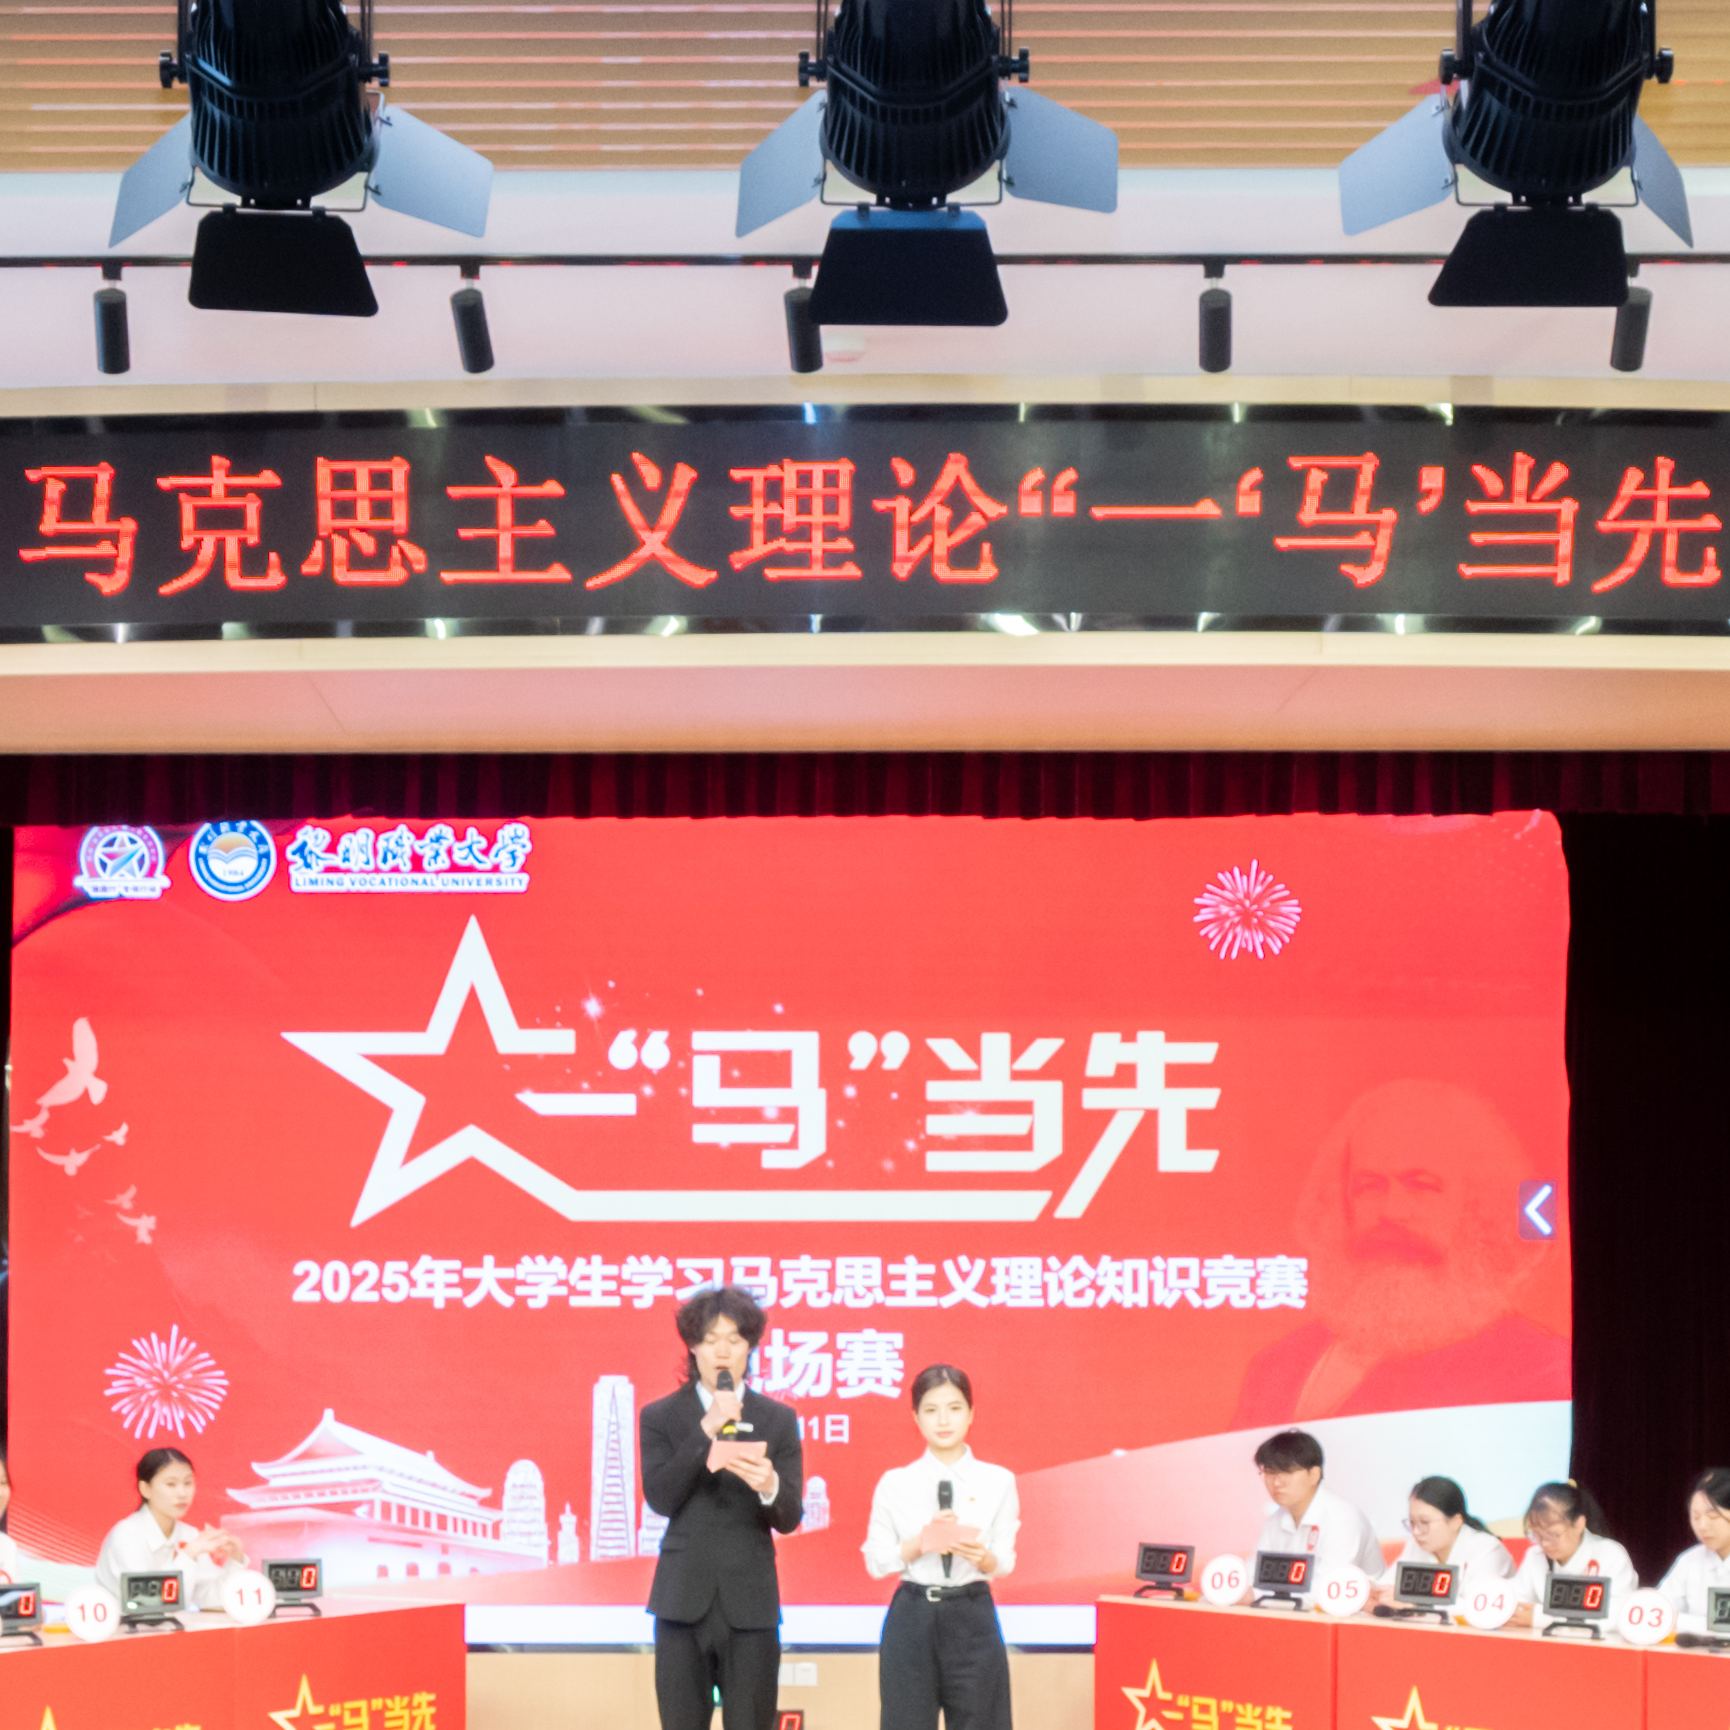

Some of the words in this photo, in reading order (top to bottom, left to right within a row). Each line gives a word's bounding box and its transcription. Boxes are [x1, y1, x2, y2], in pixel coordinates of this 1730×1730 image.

[295, 877, 345, 887] LIMING
[350, 877, 435, 887] VOCATIONAL
[442, 877, 524, 887] UNIVERSITY
[293, 1254, 1309, 1310] 2025年大学生学习马克思主义理论知识竞赛
[750, 1329, 905, 1399] 场赛
[1211, 1570, 1241, 1590] 06
[237, 1588, 263, 1607] 11
[1327, 1581, 1359, 1600] 05
[1474, 1593, 1506, 1613] 04
[78, 1603, 108, 1624] 10
[1628, 1606, 1664, 1629] 03
